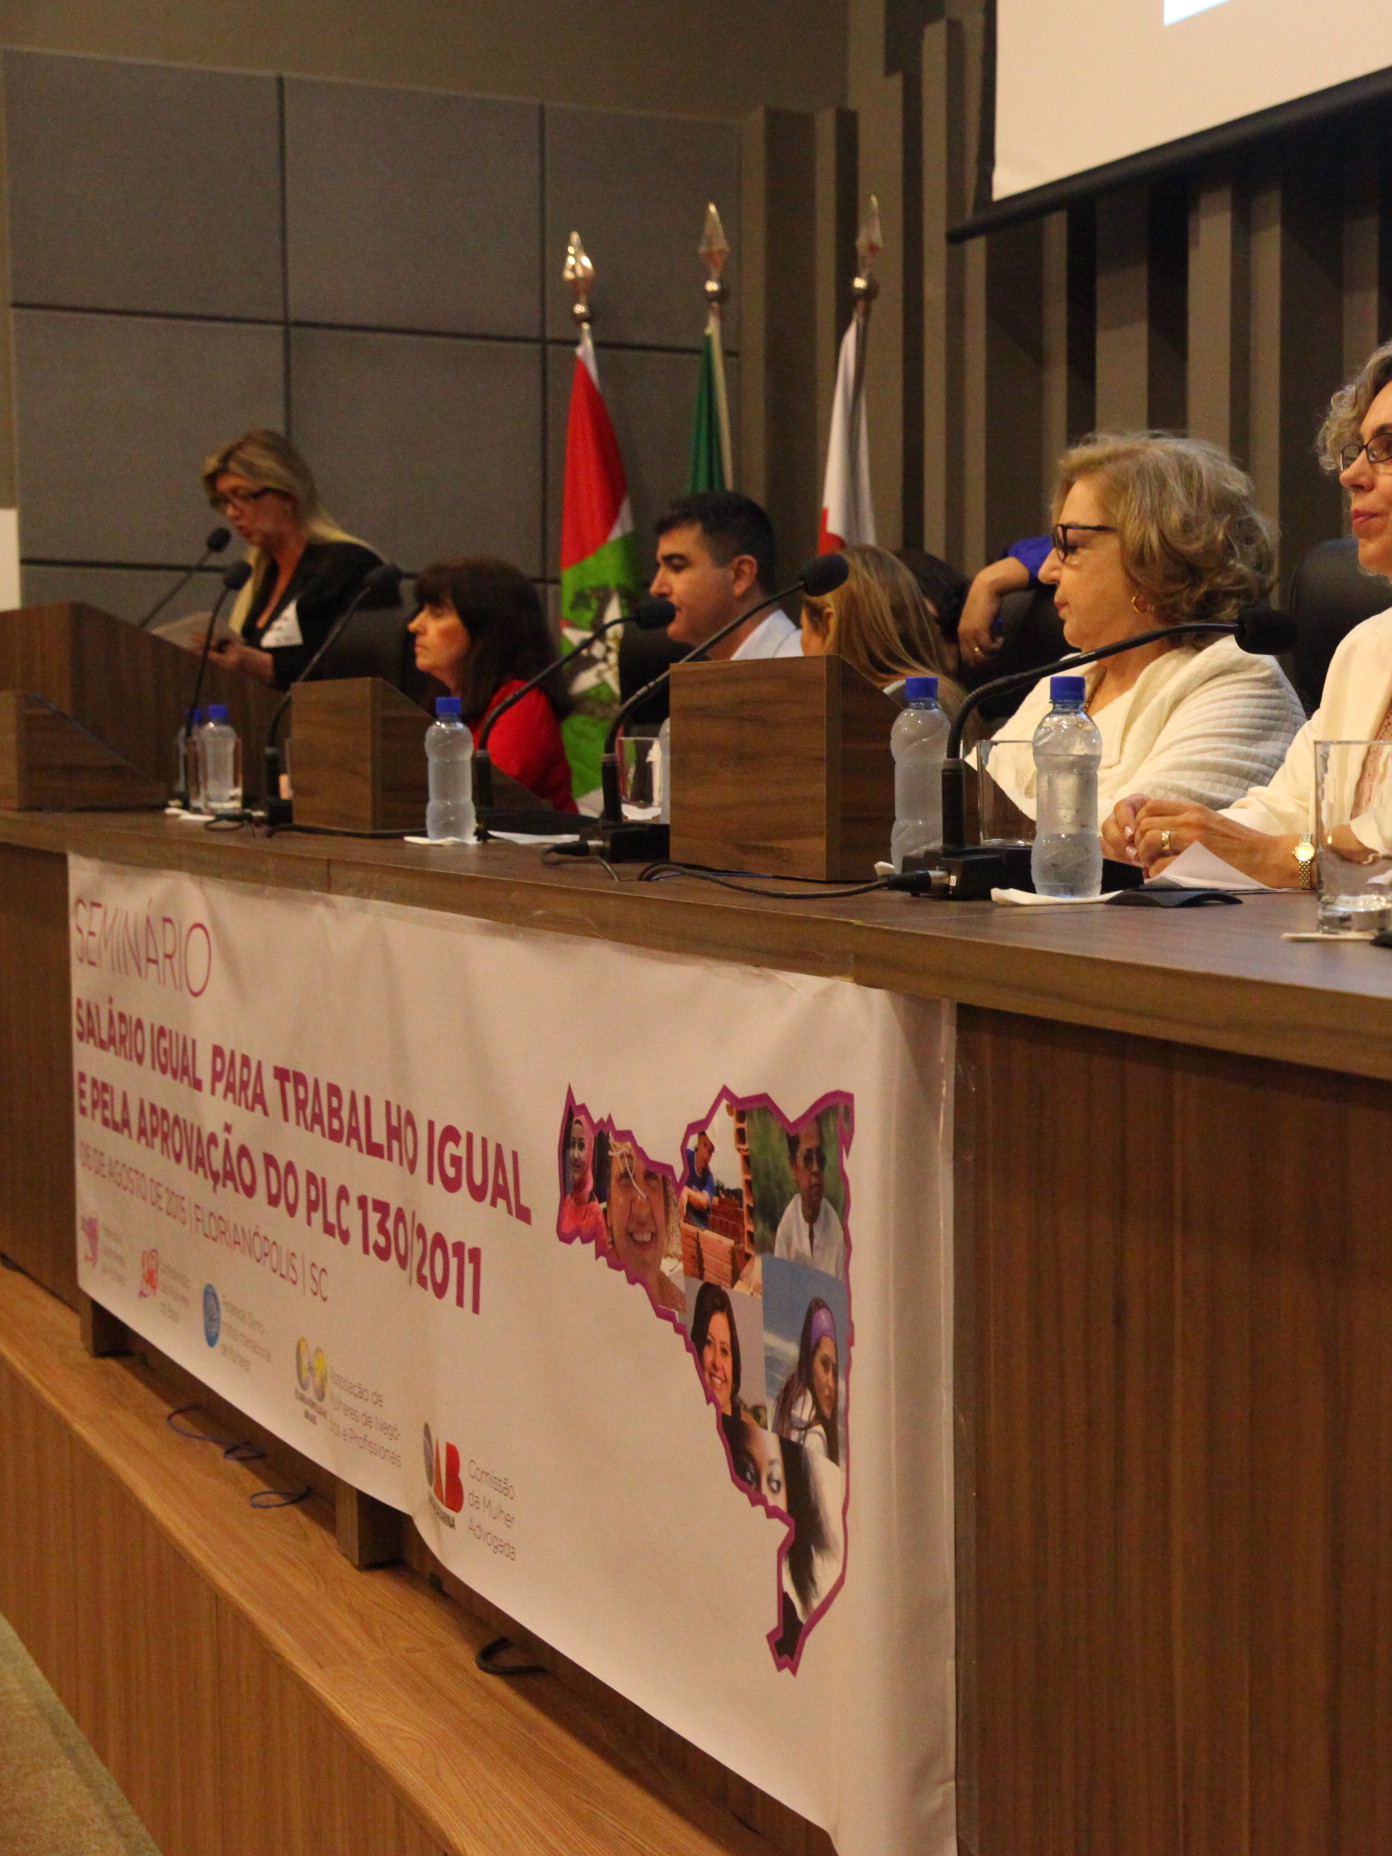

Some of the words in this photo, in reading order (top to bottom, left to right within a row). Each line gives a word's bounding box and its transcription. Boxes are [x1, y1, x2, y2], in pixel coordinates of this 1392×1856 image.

[75, 897, 212, 997] SEMINÁRIO
[76, 996, 146, 1067] SALÁRIO
[149, 1022, 203, 1093] IGUAL
[210, 1043, 269, 1117] PARA
[273, 1065, 419, 1175] TRABALHO
[426, 1119, 532, 1226] IGUAL
[78, 1070, 87, 1118] E
[90, 1076, 132, 1140] PELA
[137, 1097, 257, 1199] APROVAÇÃO
[263, 1152, 298, 1219] DO
[305, 1169, 350, 1246] PLC
[356, 1194, 481, 1316] 130/2011
[149, 1177, 163, 1211] DE
[194, 1203, 298, 1286] FLORIANÓPOLIS
[310, 1261, 329, 1303] SC
